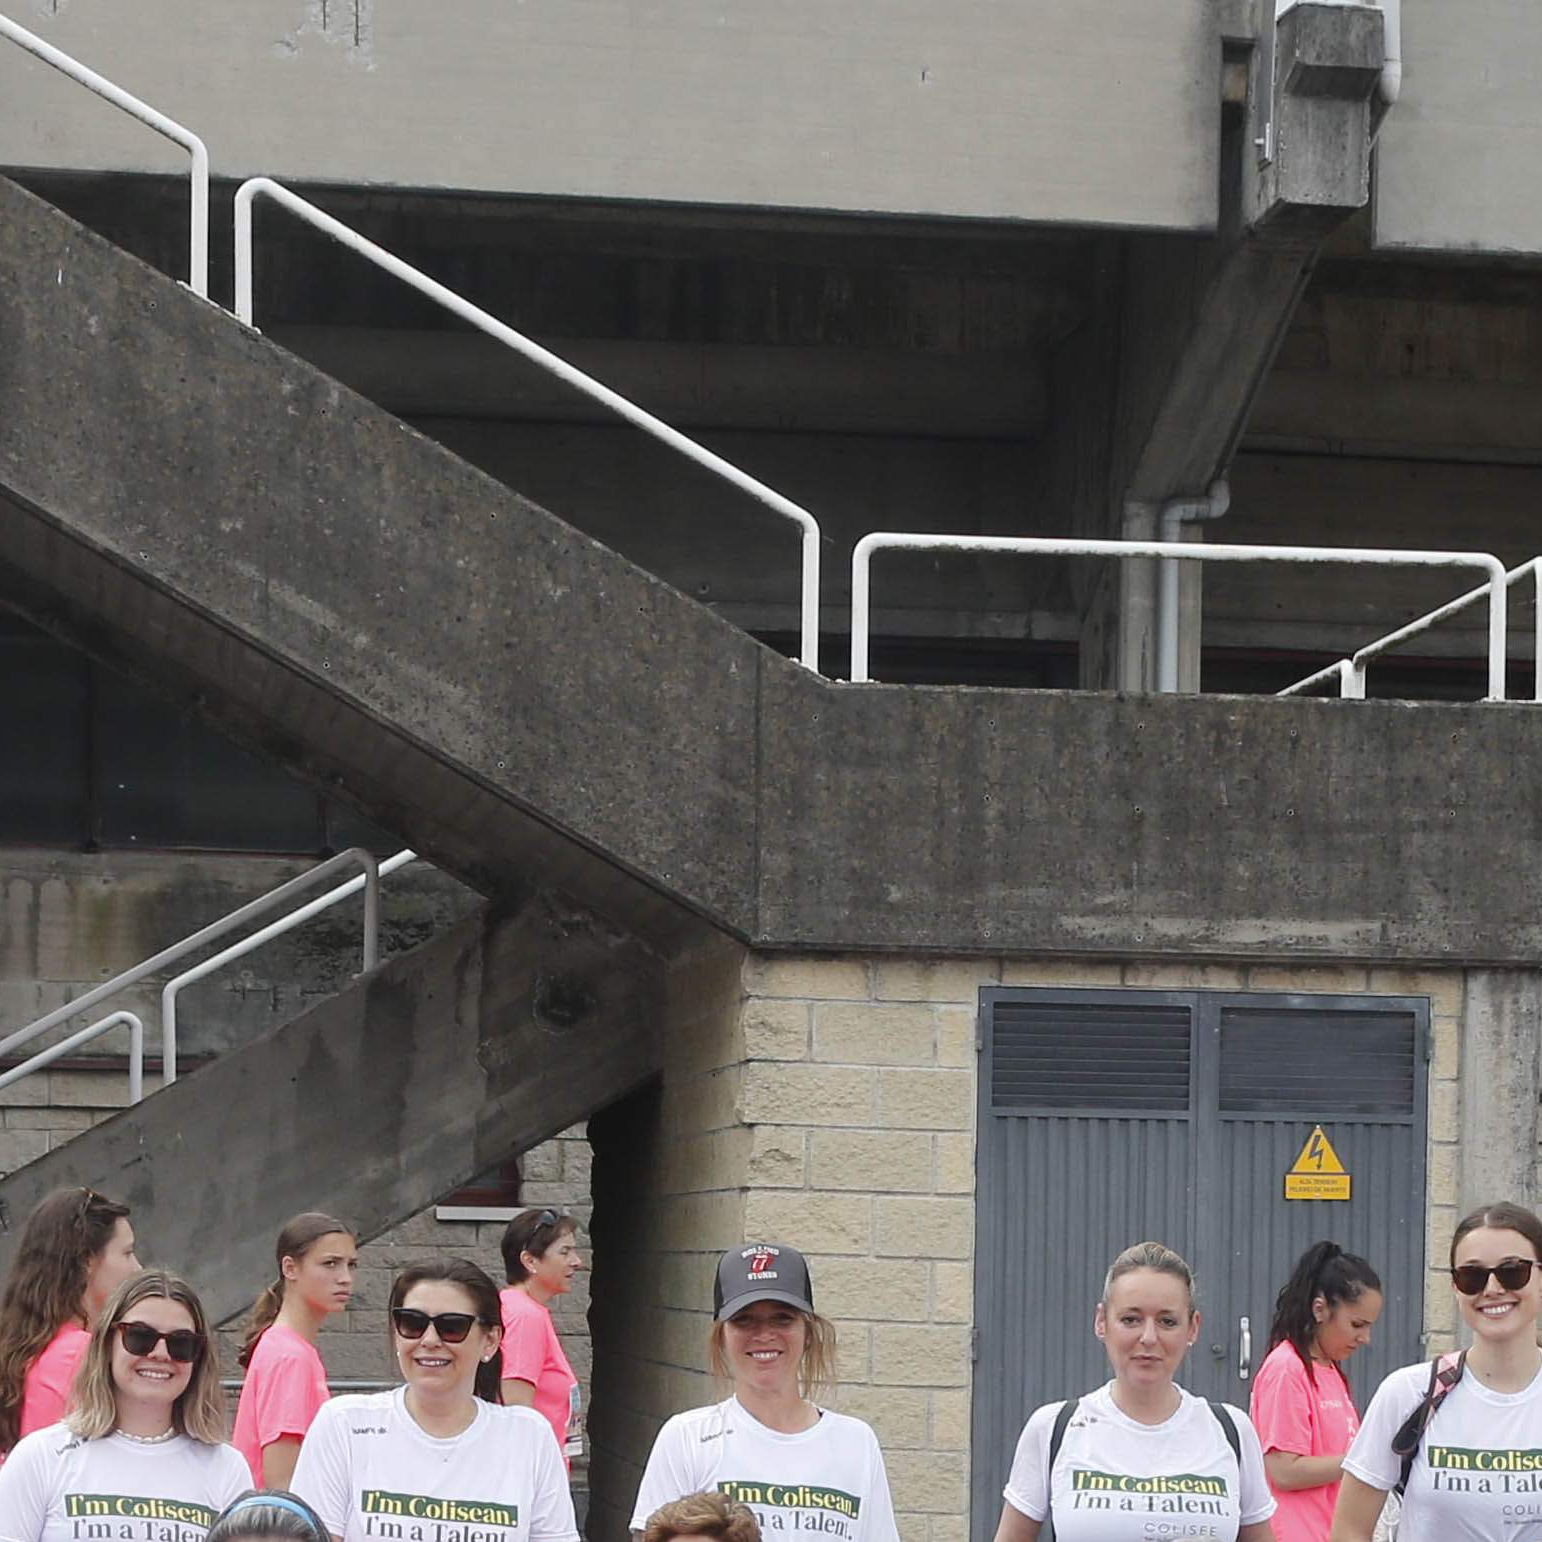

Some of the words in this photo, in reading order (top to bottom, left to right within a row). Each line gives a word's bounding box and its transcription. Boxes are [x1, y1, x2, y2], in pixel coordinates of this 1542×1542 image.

[1433, 1448, 1469, 1468] I'm
[1076, 1471, 1113, 1490] I'm
[1119, 1476, 1228, 1496] Colisean.
[1433, 1470, 1470, 1491] I'm
[1478, 1479, 1492, 1493] a
[70, 1495, 109, 1516] I'm
[115, 1498, 212, 1526] Colisean
[365, 1492, 403, 1514] I'm
[408, 1497, 518, 1526] Colisean.
[766, 1486, 858, 1517] Colisean.
[1073, 1491, 1110, 1510] I'm
[1119, 1499, 1134, 1511] a
[1145, 1495, 1230, 1517] Talent.
[72, 1518, 112, 1540] I'm
[119, 1527, 134, 1540] a
[365, 1516, 403, 1539] I'm
[410, 1526, 424, 1542] a
[771, 1514, 784, 1530] a
[1144, 1522, 1219, 1536] COLISEE
